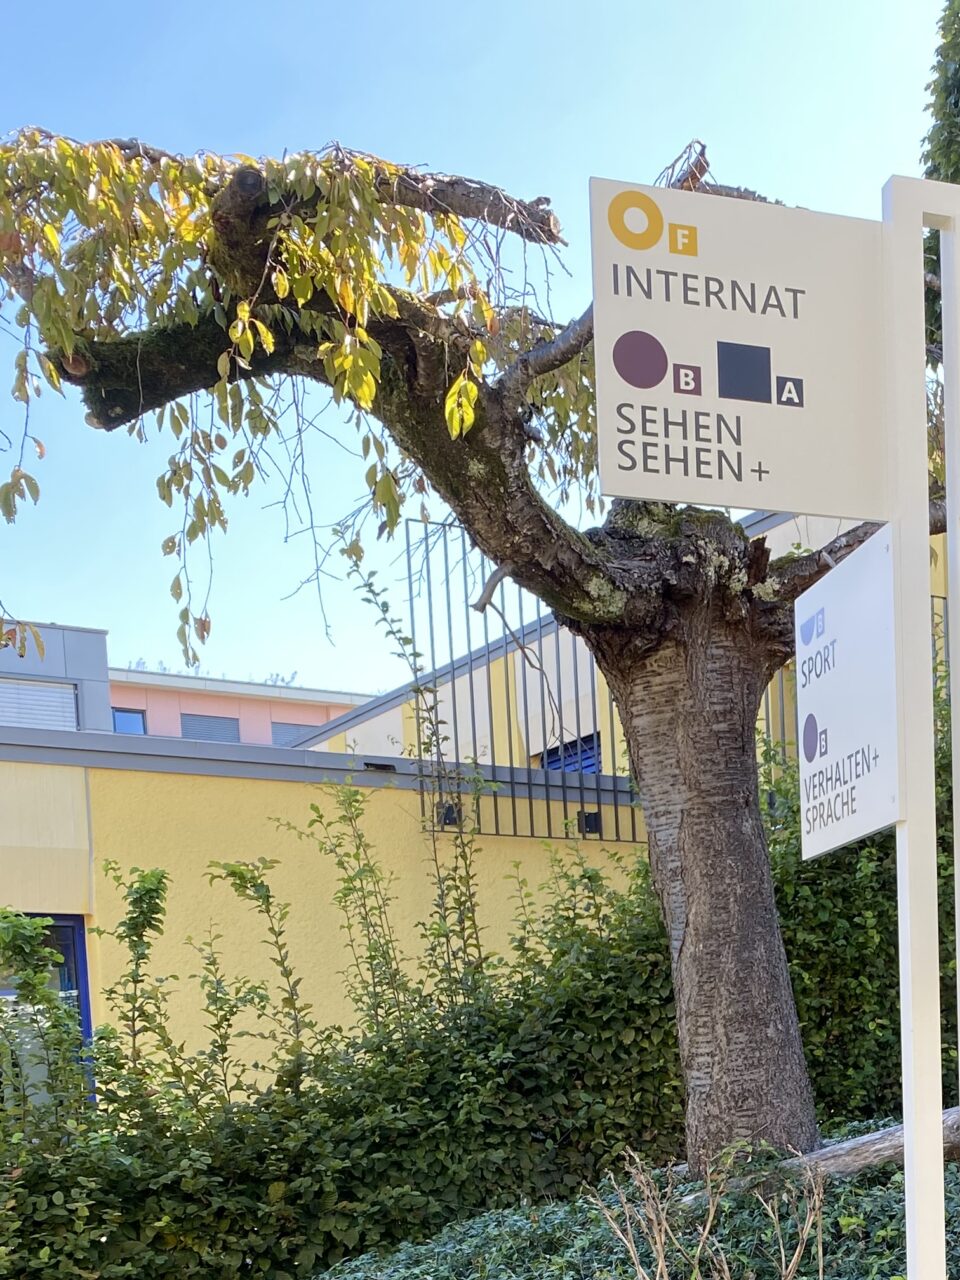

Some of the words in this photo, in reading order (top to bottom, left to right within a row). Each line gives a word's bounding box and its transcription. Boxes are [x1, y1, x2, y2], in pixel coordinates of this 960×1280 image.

[676, 229, 689, 250] F
[612, 263, 806, 319] INTERNAT
[679, 369, 695, 391] B
[780, 381, 799, 403] A
[615, 402, 742, 446] SEHEN
[617, 439, 770, 482] SEHEN+
[801, 638, 837, 689] SPORT
[804, 744, 880, 804] VERHALTEN+
[805, 786, 857, 835] SPRACHE
